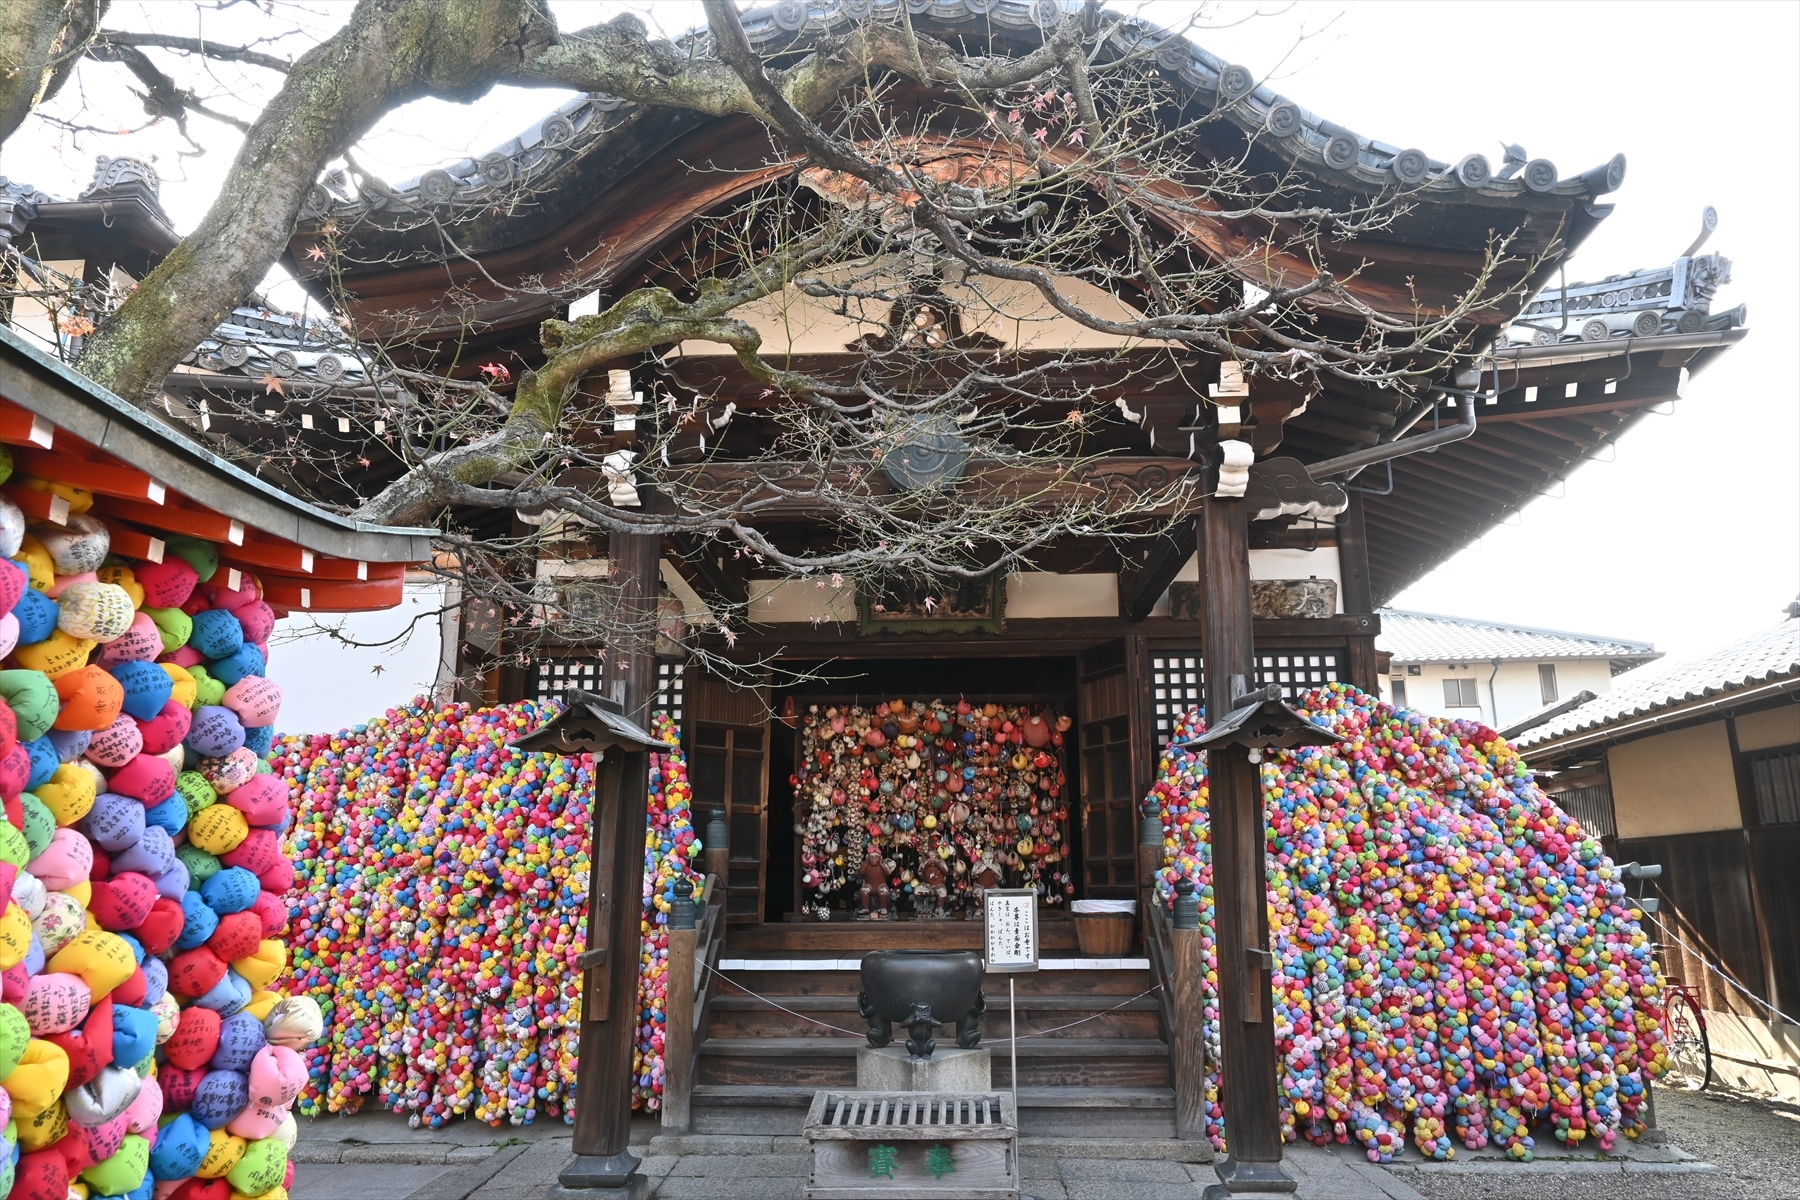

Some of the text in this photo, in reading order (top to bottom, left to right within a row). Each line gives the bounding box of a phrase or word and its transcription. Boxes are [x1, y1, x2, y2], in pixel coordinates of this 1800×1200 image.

[1013, 906, 1021, 956] 本尊は青面金剛
